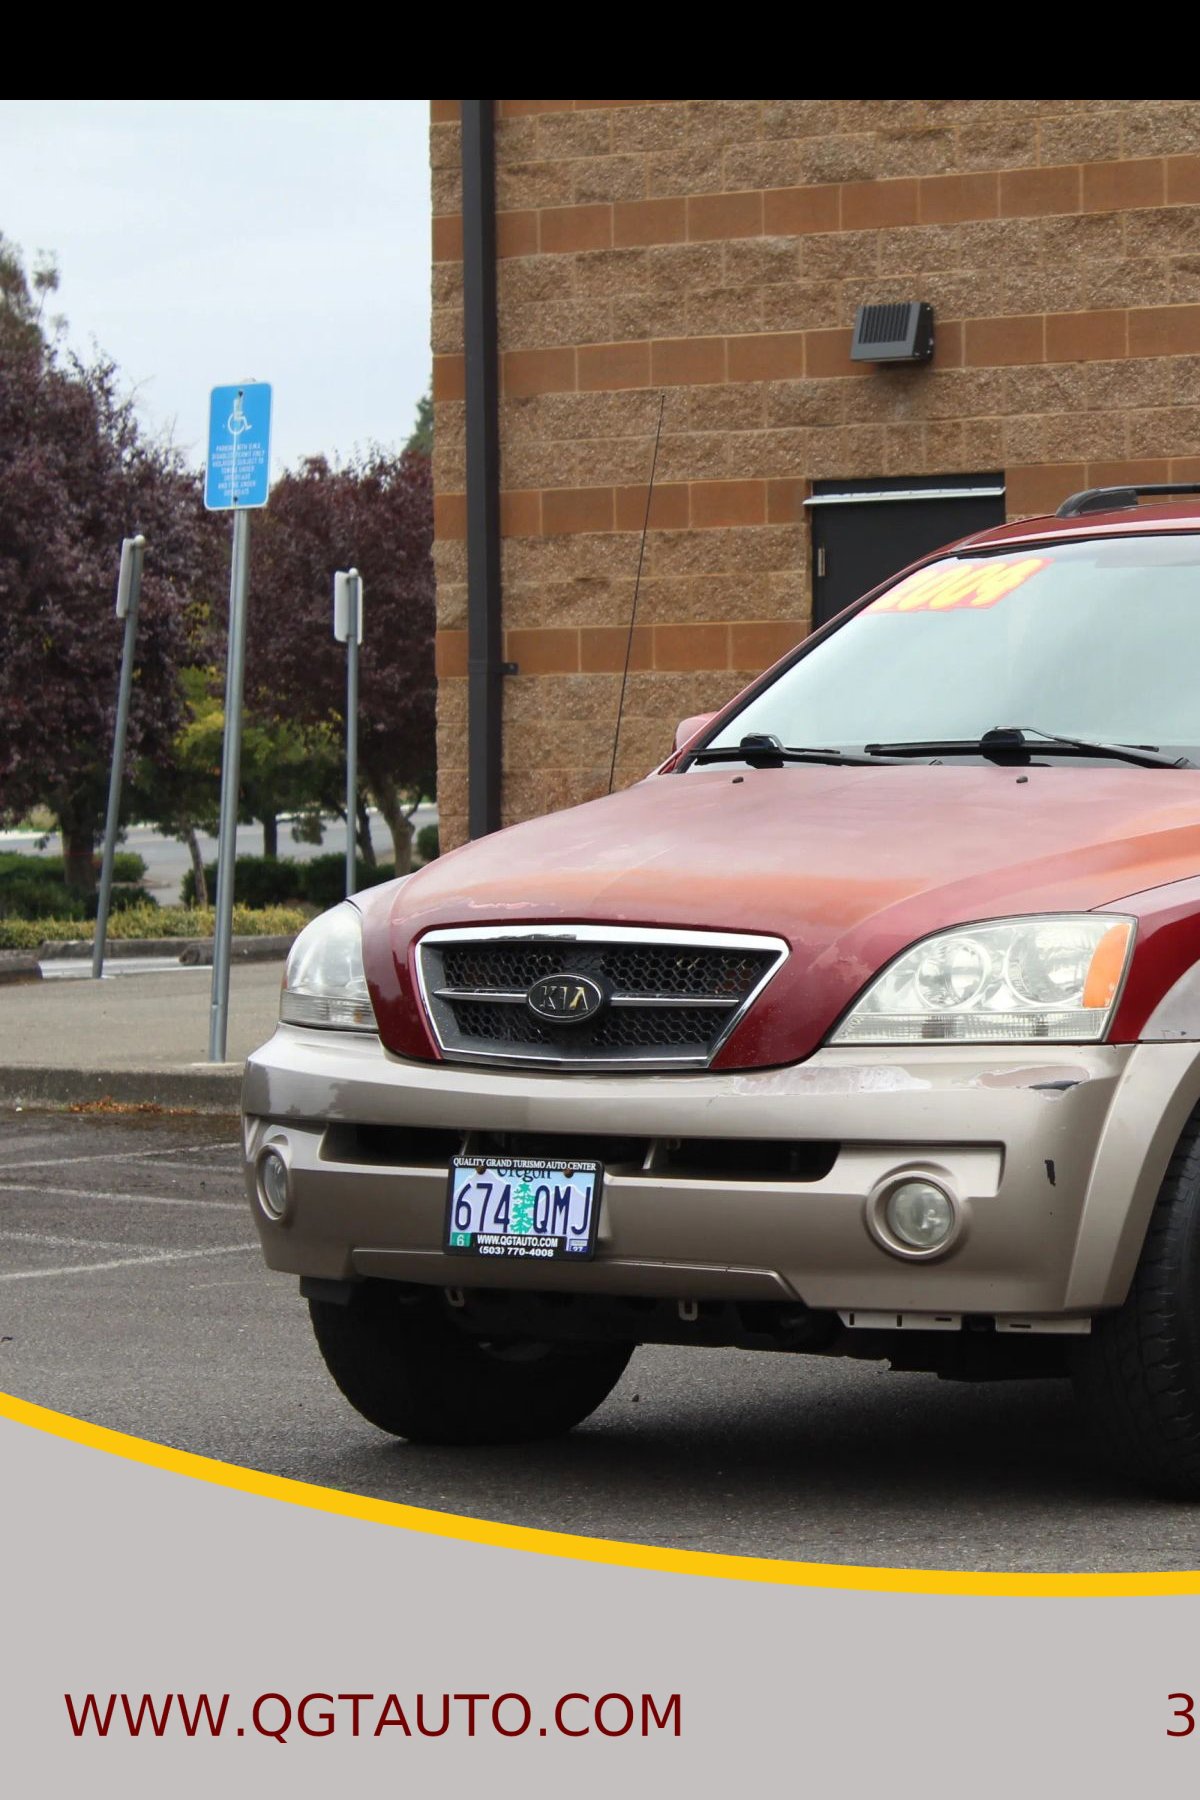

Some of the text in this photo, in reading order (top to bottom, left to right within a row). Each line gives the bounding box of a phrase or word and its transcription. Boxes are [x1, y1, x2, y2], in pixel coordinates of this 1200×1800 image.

[540, 985, 588, 1010] KIA
[453, 1157, 597, 1171] QUALITY GRAND TURISMO AUTO CENTER
[455, 1182, 591, 1235] 674 QMJ
[456, 1234, 465, 1247] 6
[477, 1234, 558, 1248] WWW.QGTAUTO.COM
[479, 1246, 554, 1257] (503) 770-4008
